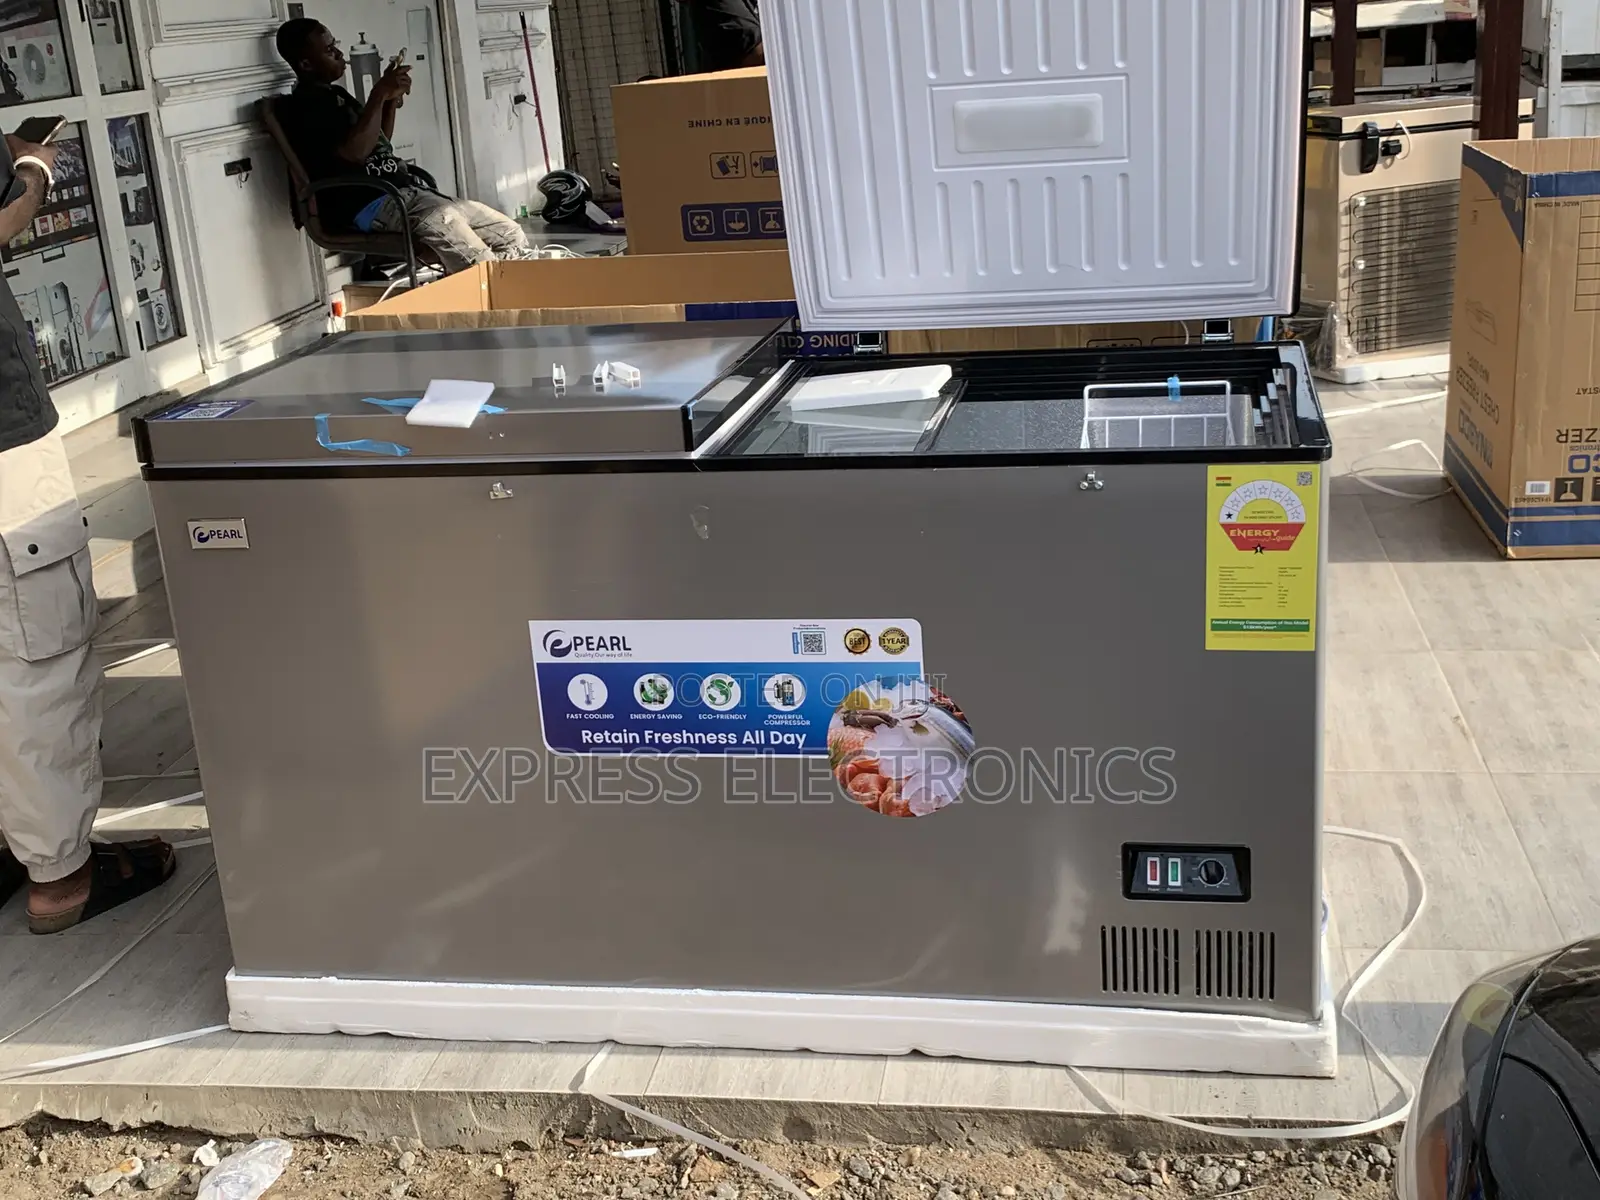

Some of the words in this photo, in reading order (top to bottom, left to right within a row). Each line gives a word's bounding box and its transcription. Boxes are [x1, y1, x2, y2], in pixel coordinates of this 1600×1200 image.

[687, 119, 722, 128] CHINE
[726, 118, 741, 126] EN
[810, 333, 857, 348] IDING
[1556, 428, 1600, 444] ZER
[1229, 528, 1280, 539] ENERGY
[573, 636, 632, 651] PEARL
[849, 638, 866, 646] BEST
[581, 729, 640, 744] Retain
[644, 729, 738, 744] Freshness
[742, 730, 765, 744] All
[769, 731, 807, 749] Day
